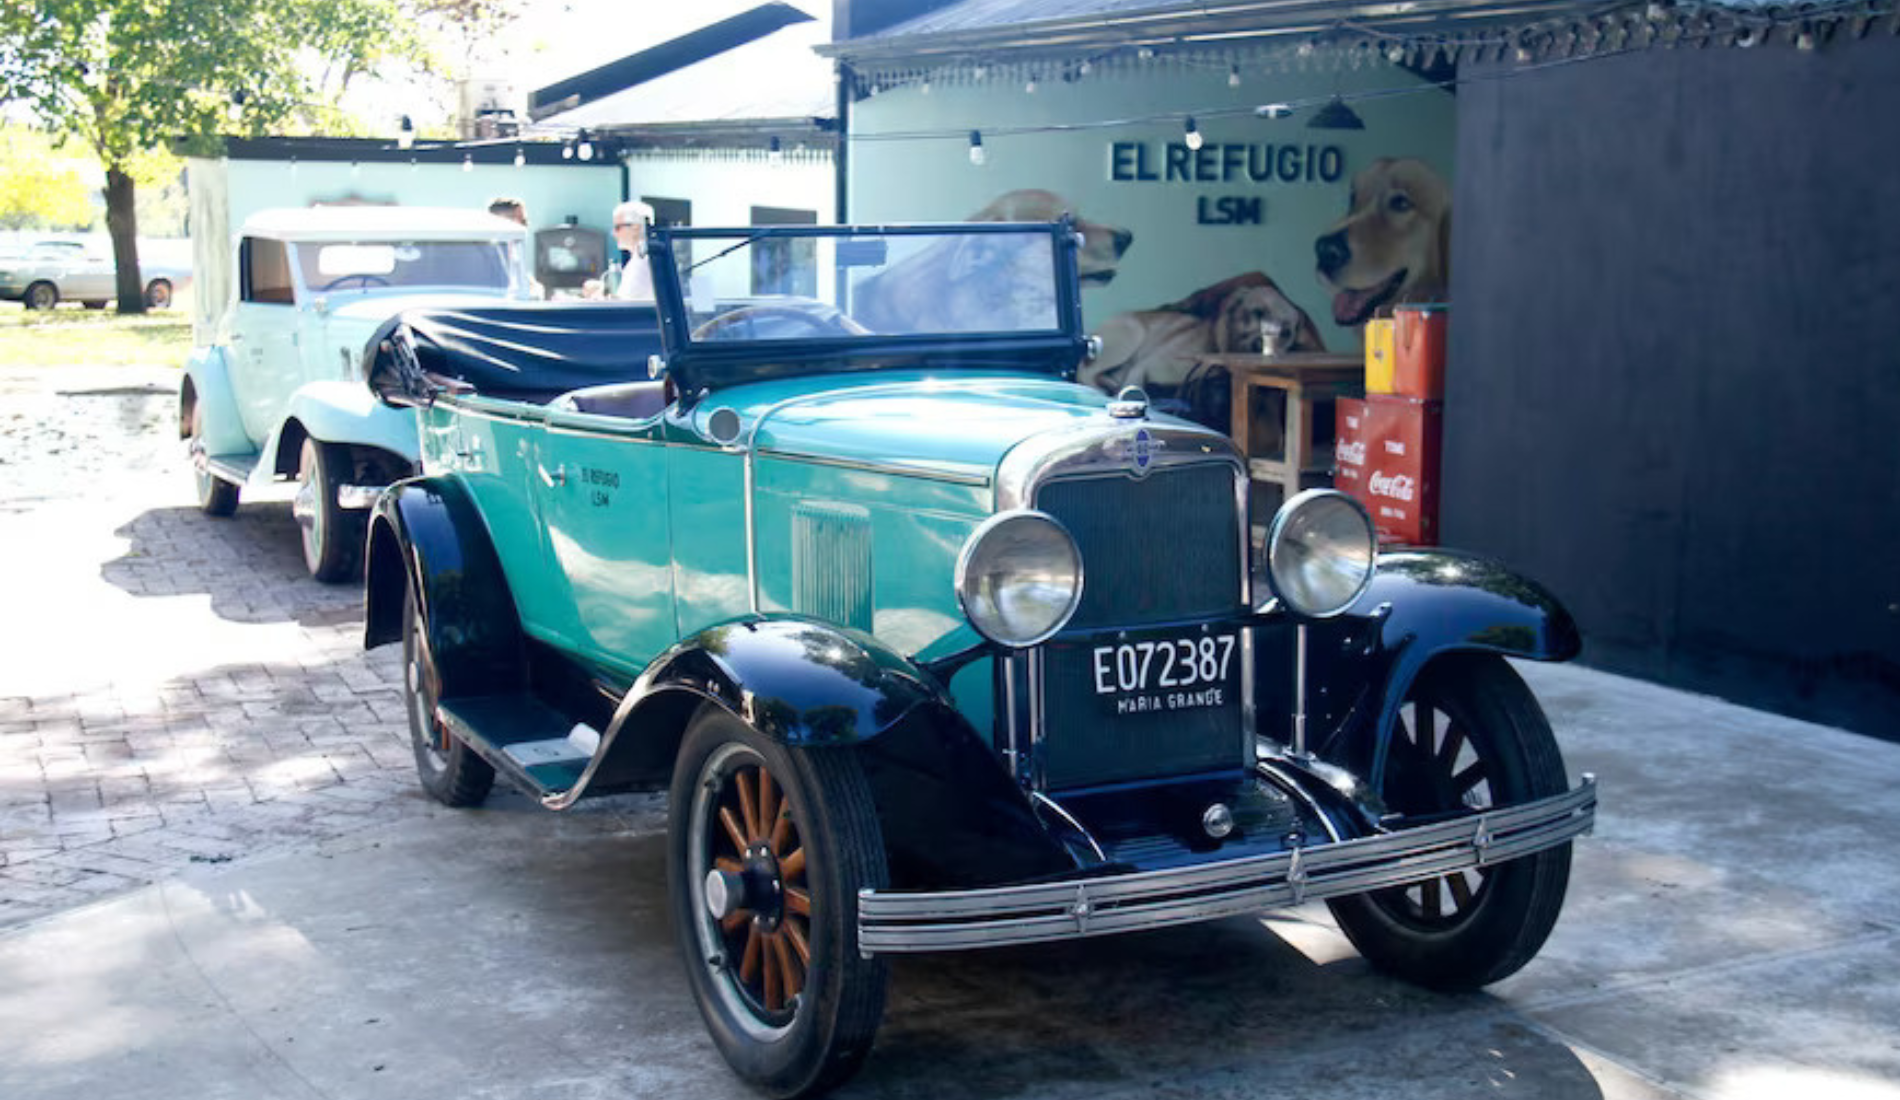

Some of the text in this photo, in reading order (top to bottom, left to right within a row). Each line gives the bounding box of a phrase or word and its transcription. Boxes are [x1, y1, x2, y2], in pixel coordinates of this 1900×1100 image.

[1110, 142, 1343, 183] EL REFUGIO
[1197, 196, 1263, 225] LSM
[1094, 635, 1236, 694] E072387
[1118, 688, 1224, 714] MARIA GRANDE
